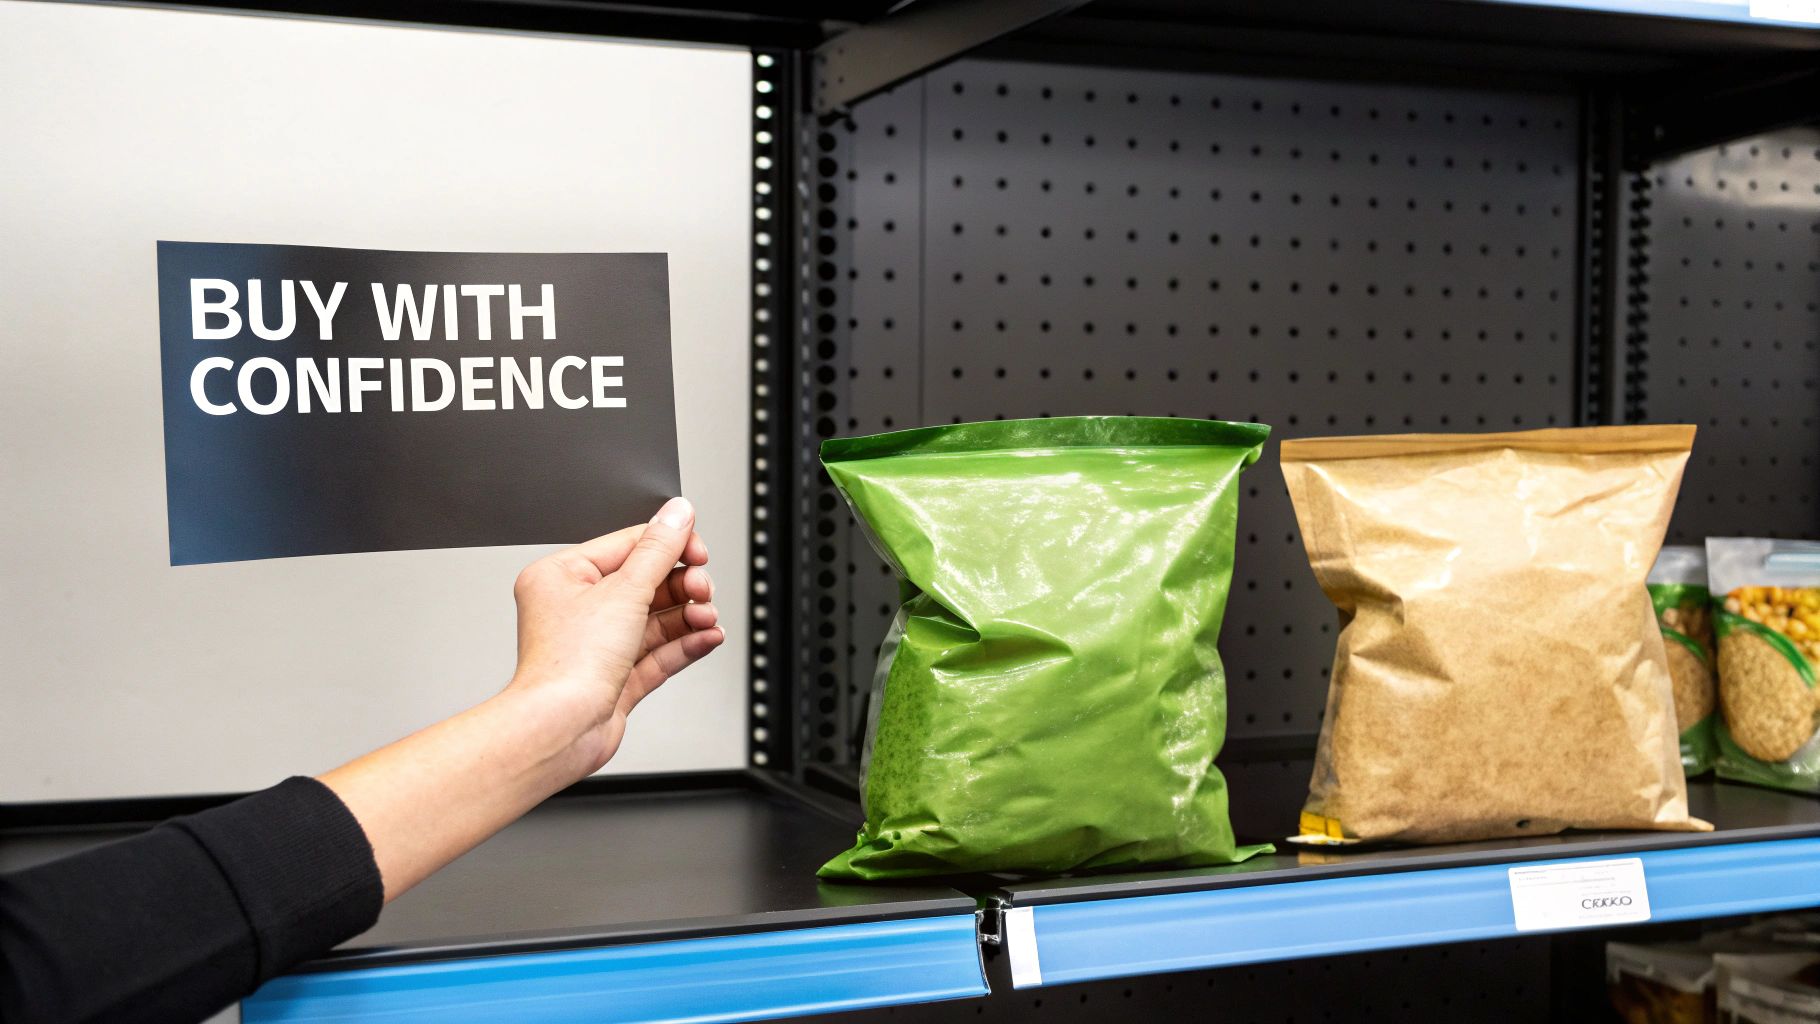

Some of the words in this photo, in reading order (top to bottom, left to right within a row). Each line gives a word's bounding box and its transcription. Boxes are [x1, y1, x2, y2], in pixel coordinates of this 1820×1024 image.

[190, 278, 348, 341] BUY
[371, 282, 557, 341] WITH
[190, 356, 627, 415] CONFIDENCE
